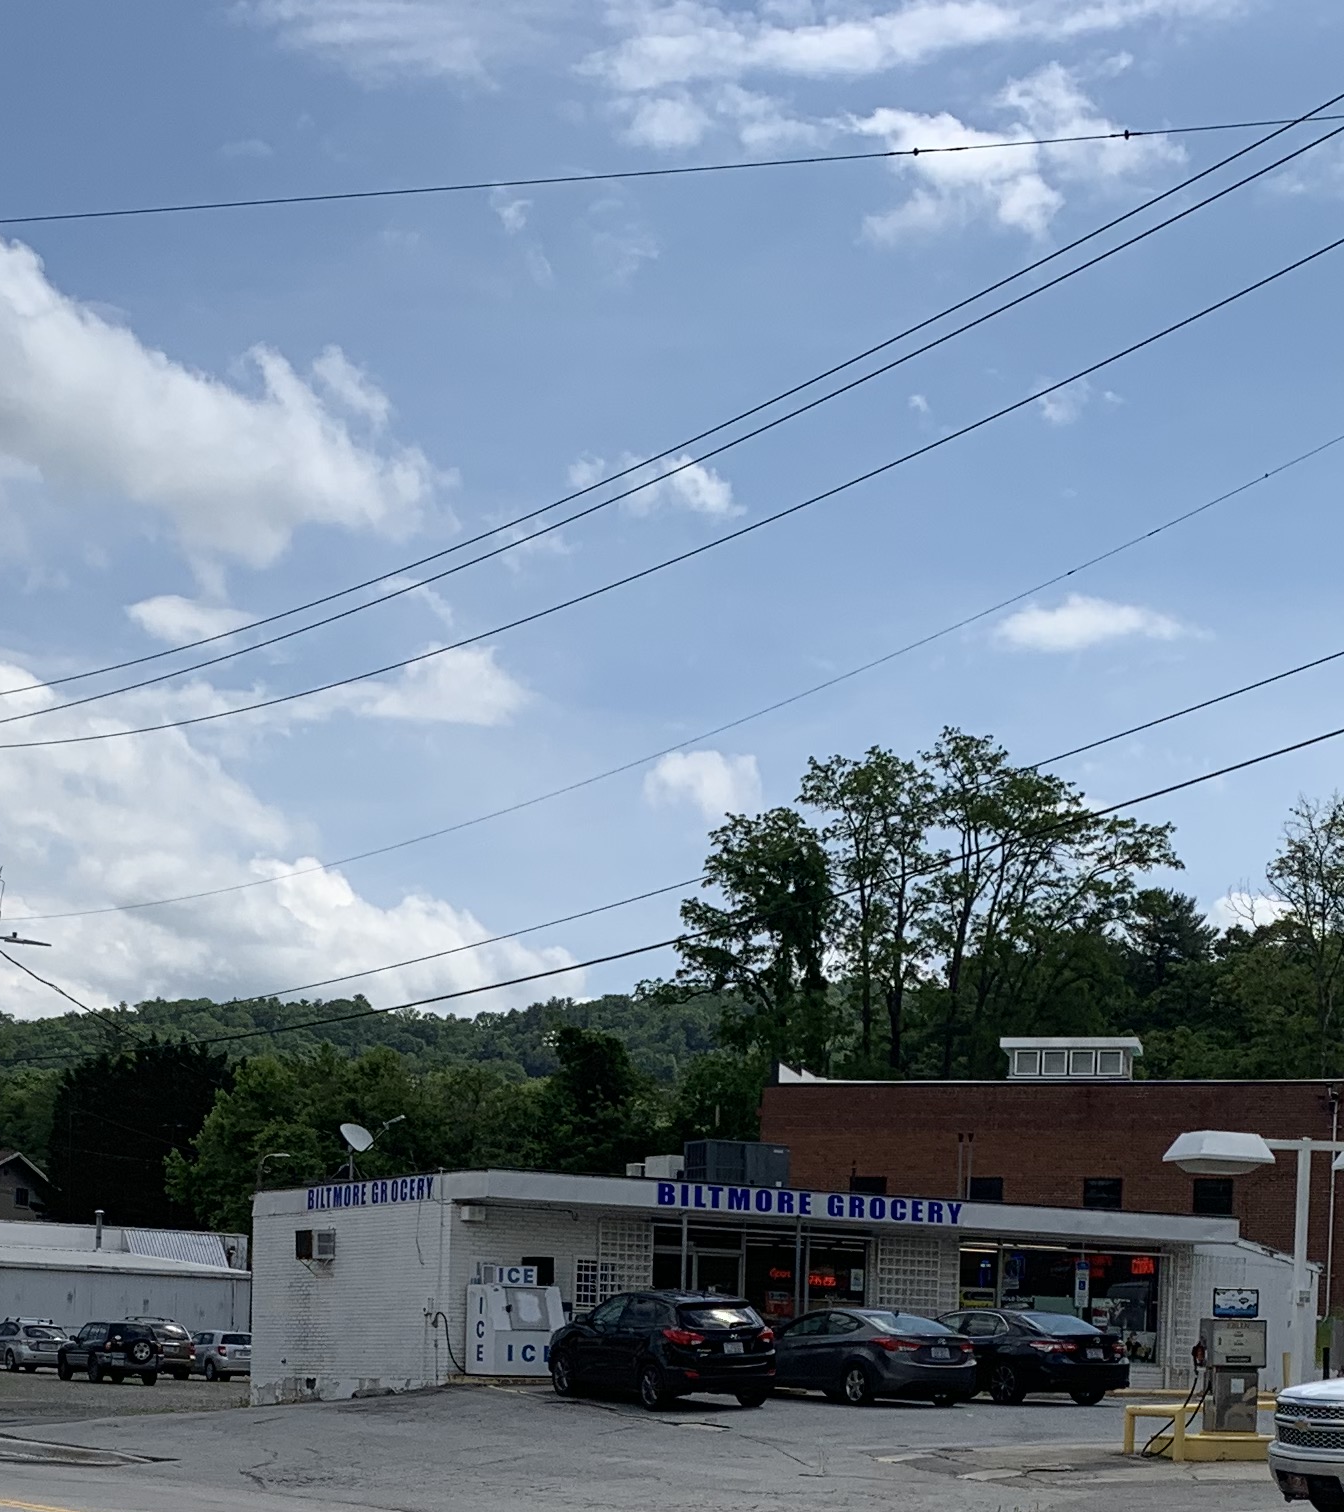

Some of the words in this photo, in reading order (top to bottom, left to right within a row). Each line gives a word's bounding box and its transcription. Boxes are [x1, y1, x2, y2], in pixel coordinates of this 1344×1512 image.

[307, 1183, 366, 1210] BILTMORE
[371, 1177, 434, 1204] GROCERY
[657, 1182, 811, 1215] BILTMORE
[827, 1194, 962, 1225] GROCERY
[498, 1267, 534, 1284] ICE
[476, 1296, 485, 1362] ICE
